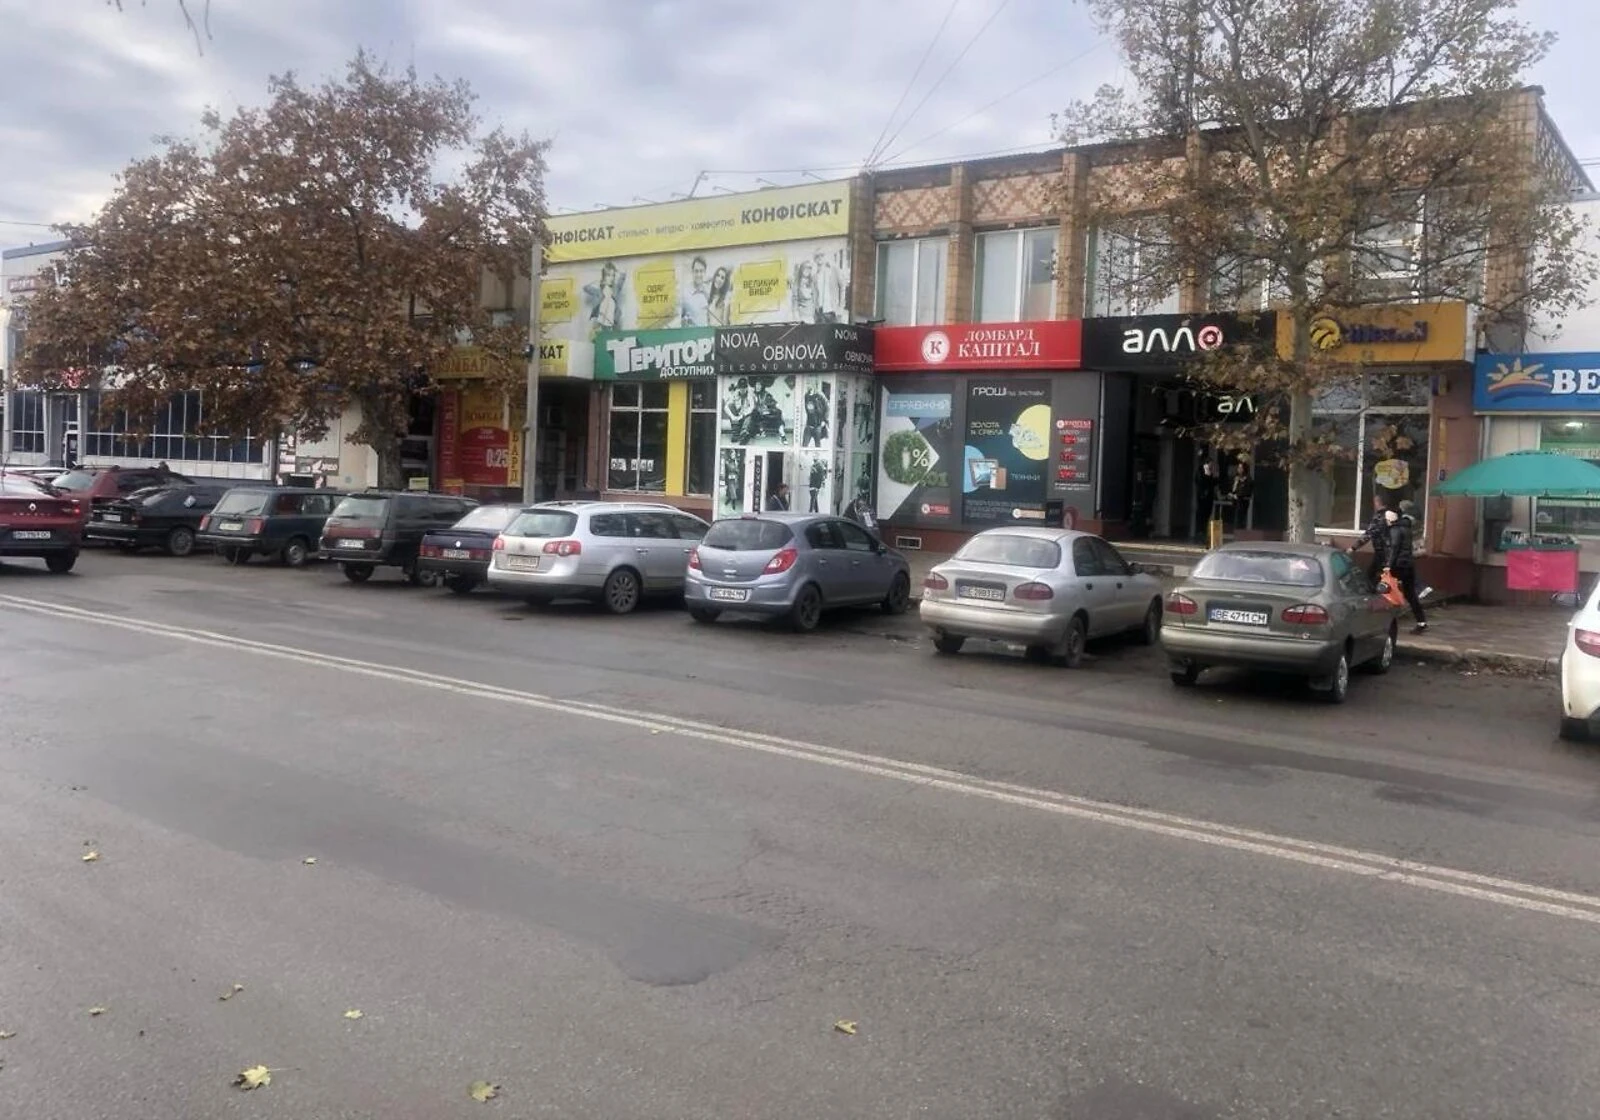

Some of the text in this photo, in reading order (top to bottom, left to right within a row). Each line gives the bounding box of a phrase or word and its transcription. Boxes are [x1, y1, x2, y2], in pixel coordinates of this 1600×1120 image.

[550, 226, 615, 245] НФІСКАТ
[741, 199, 842, 224] КОНФІСКАТ
[743, 278, 779, 289] ВЕЛИКИЙ
[720, 332, 760, 349] NOVA
[834, 329, 858, 341] NOVA
[964, 328, 1033, 342] ЛОМБАРД
[763, 344, 827, 361] OBNOVA
[958, 342, 1040, 358] КАПІТАЛ
